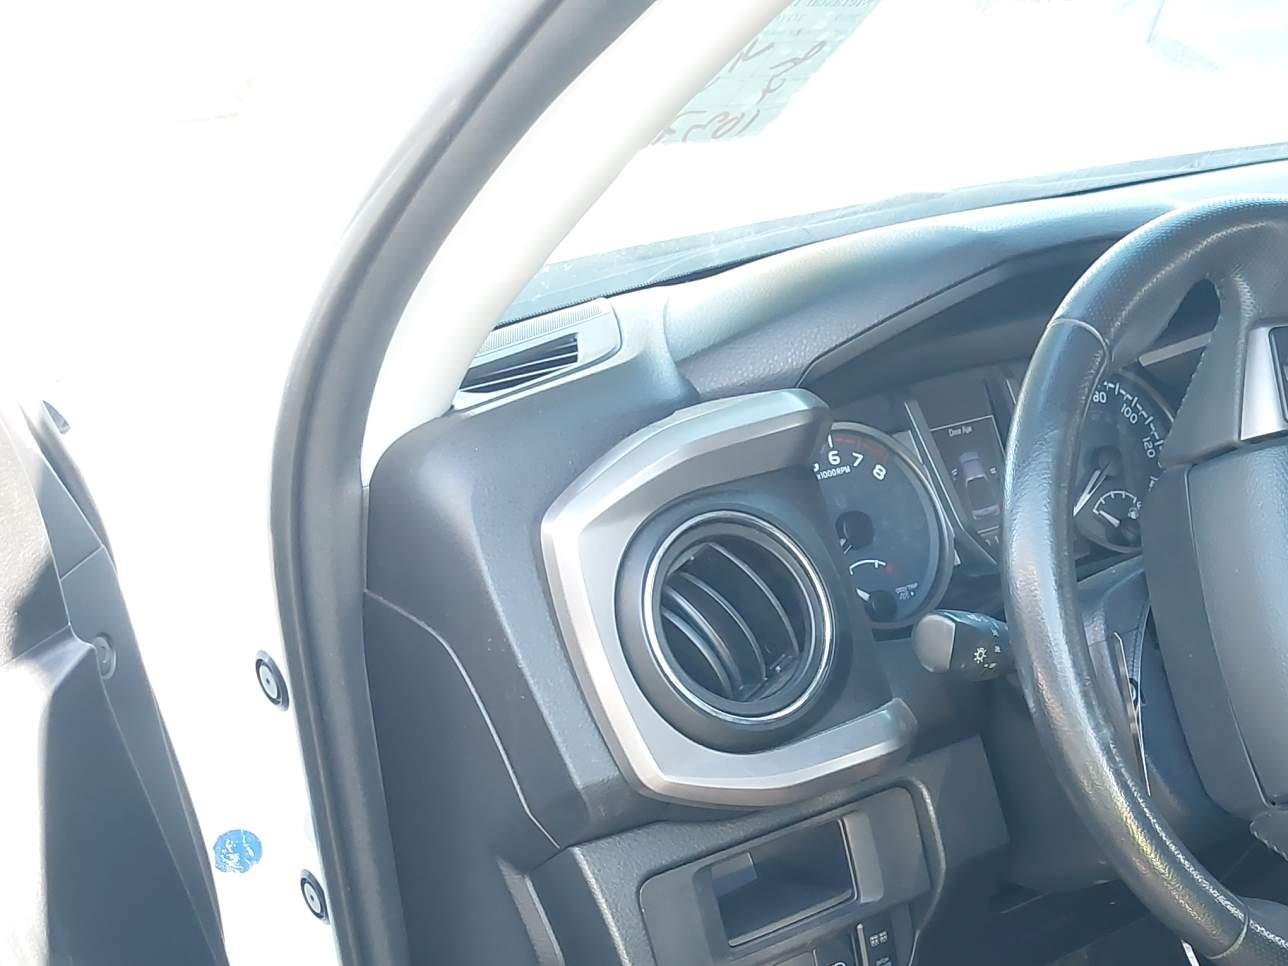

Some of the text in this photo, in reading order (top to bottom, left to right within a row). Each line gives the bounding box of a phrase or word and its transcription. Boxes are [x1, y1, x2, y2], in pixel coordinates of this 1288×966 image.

[1120, 403, 1138, 424] 100
[1142, 437, 1156, 458] 120
[828, 450, 841, 465] 6
[851, 451, 864, 467] 7
[873, 464, 887, 480] 8
